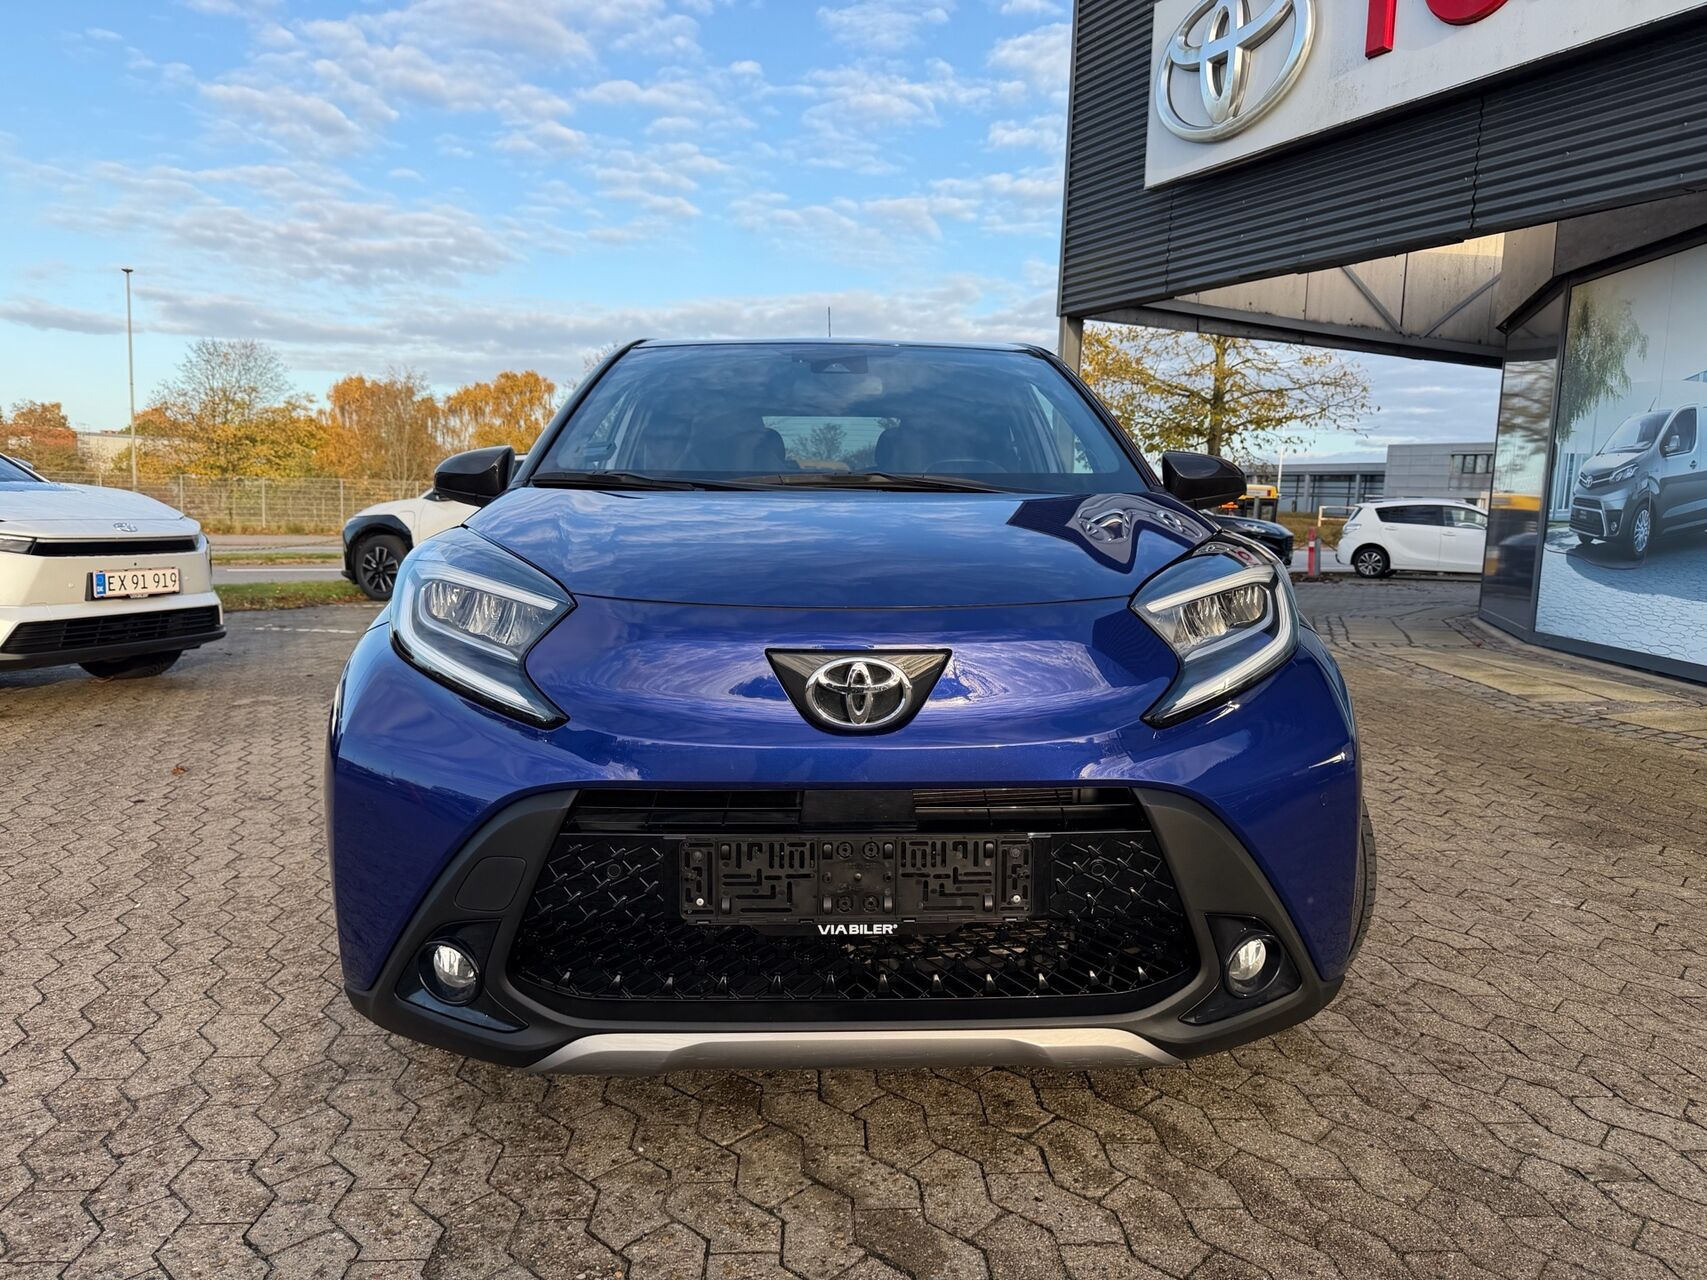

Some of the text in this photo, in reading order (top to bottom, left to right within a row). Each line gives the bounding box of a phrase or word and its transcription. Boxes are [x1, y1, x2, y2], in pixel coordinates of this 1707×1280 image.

[108, 572, 177, 592] EX 91 919
